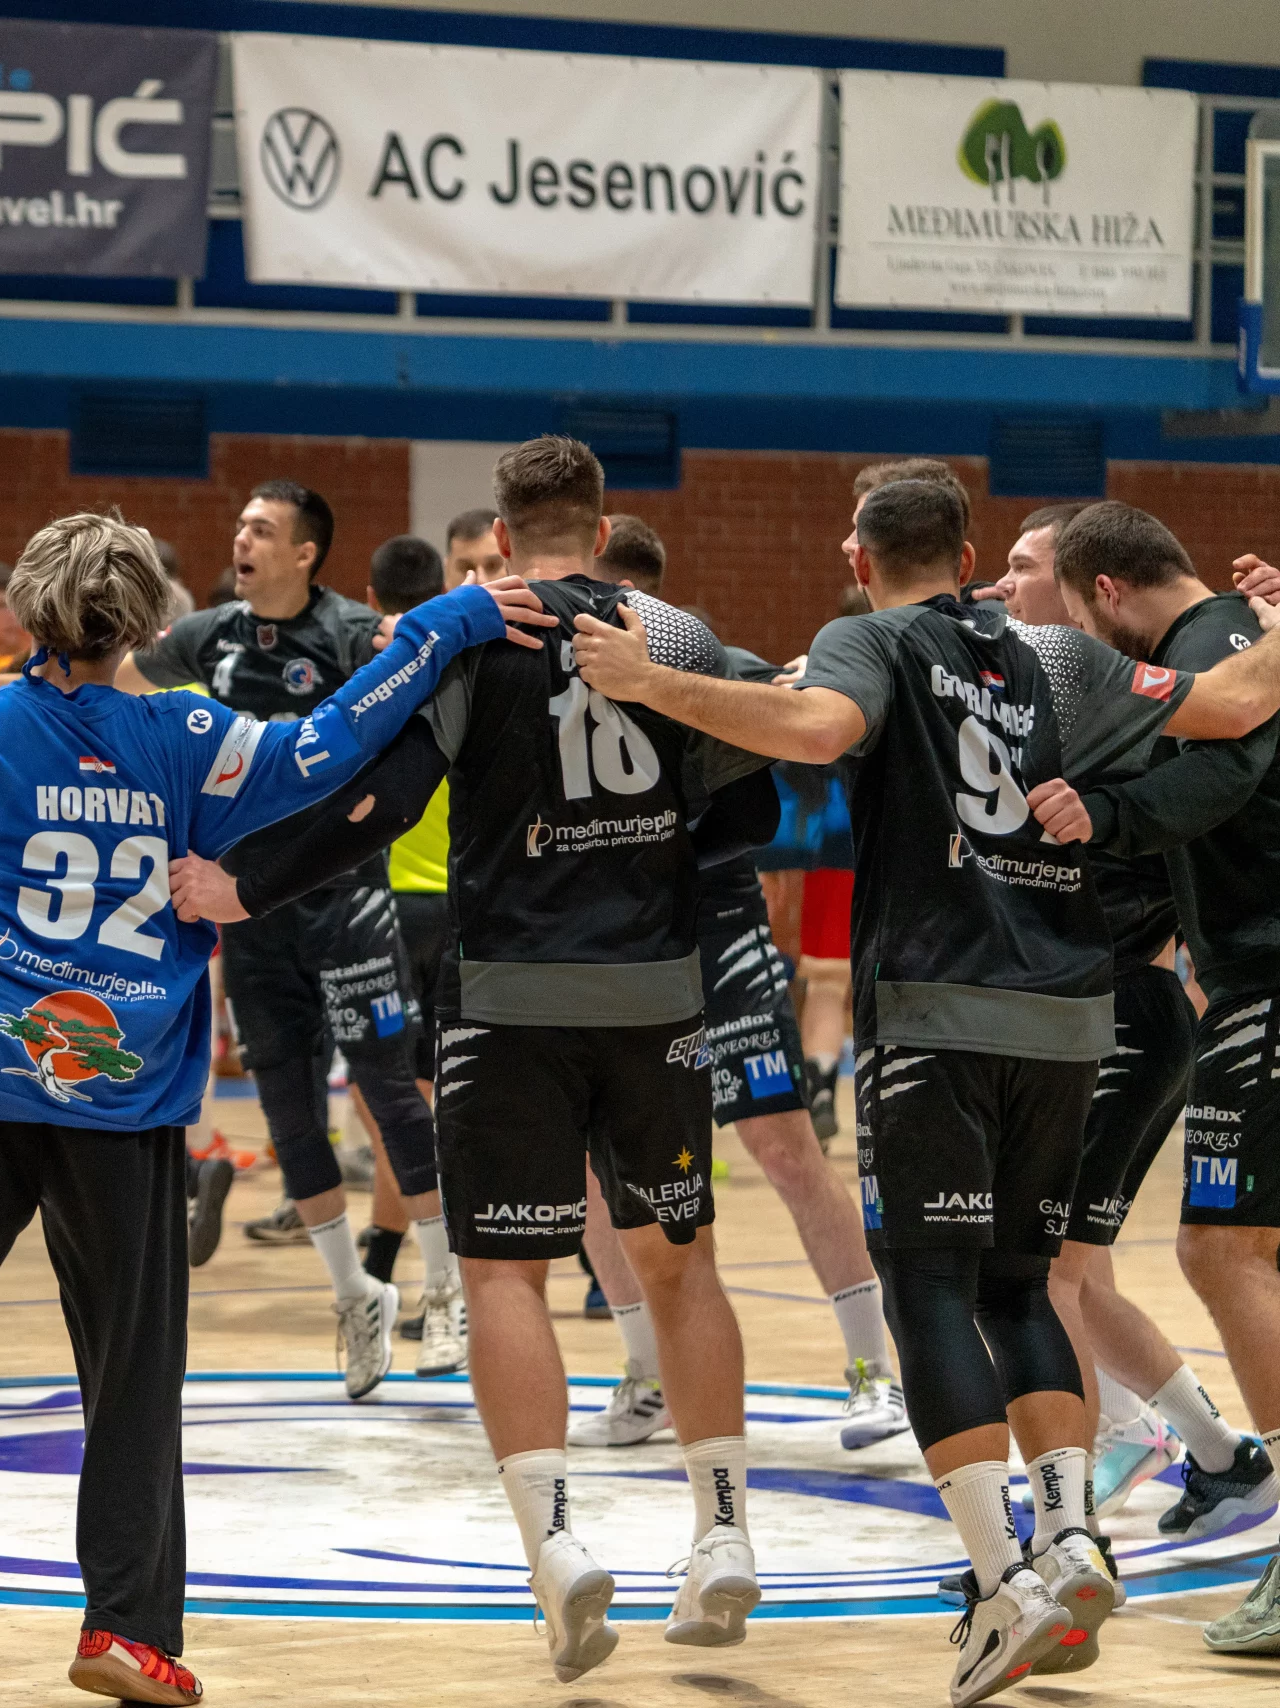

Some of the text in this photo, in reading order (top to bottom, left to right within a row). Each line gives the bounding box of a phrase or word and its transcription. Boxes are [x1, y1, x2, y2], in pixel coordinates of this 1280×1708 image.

[369, 132, 806, 218] AC Jesenović
[549, 676, 661, 801] 18
[957, 714, 1032, 835] 9
[36, 785, 166, 827] HORVAT
[556, 843, 570, 852] za
[611, 833, 659, 847] prirodnim
[17, 831, 169, 961] 32
[1008, 876, 1057, 890] prirodnim
[19, 949, 167, 997] međimurjeplin
[370, 990, 402, 1020] TM
[743, 1049, 789, 1081] TM
[1191, 1155, 1238, 1186] TM
[711, 1467, 736, 1527] Kempa
[1040, 1463, 1064, 1513] Kempa
